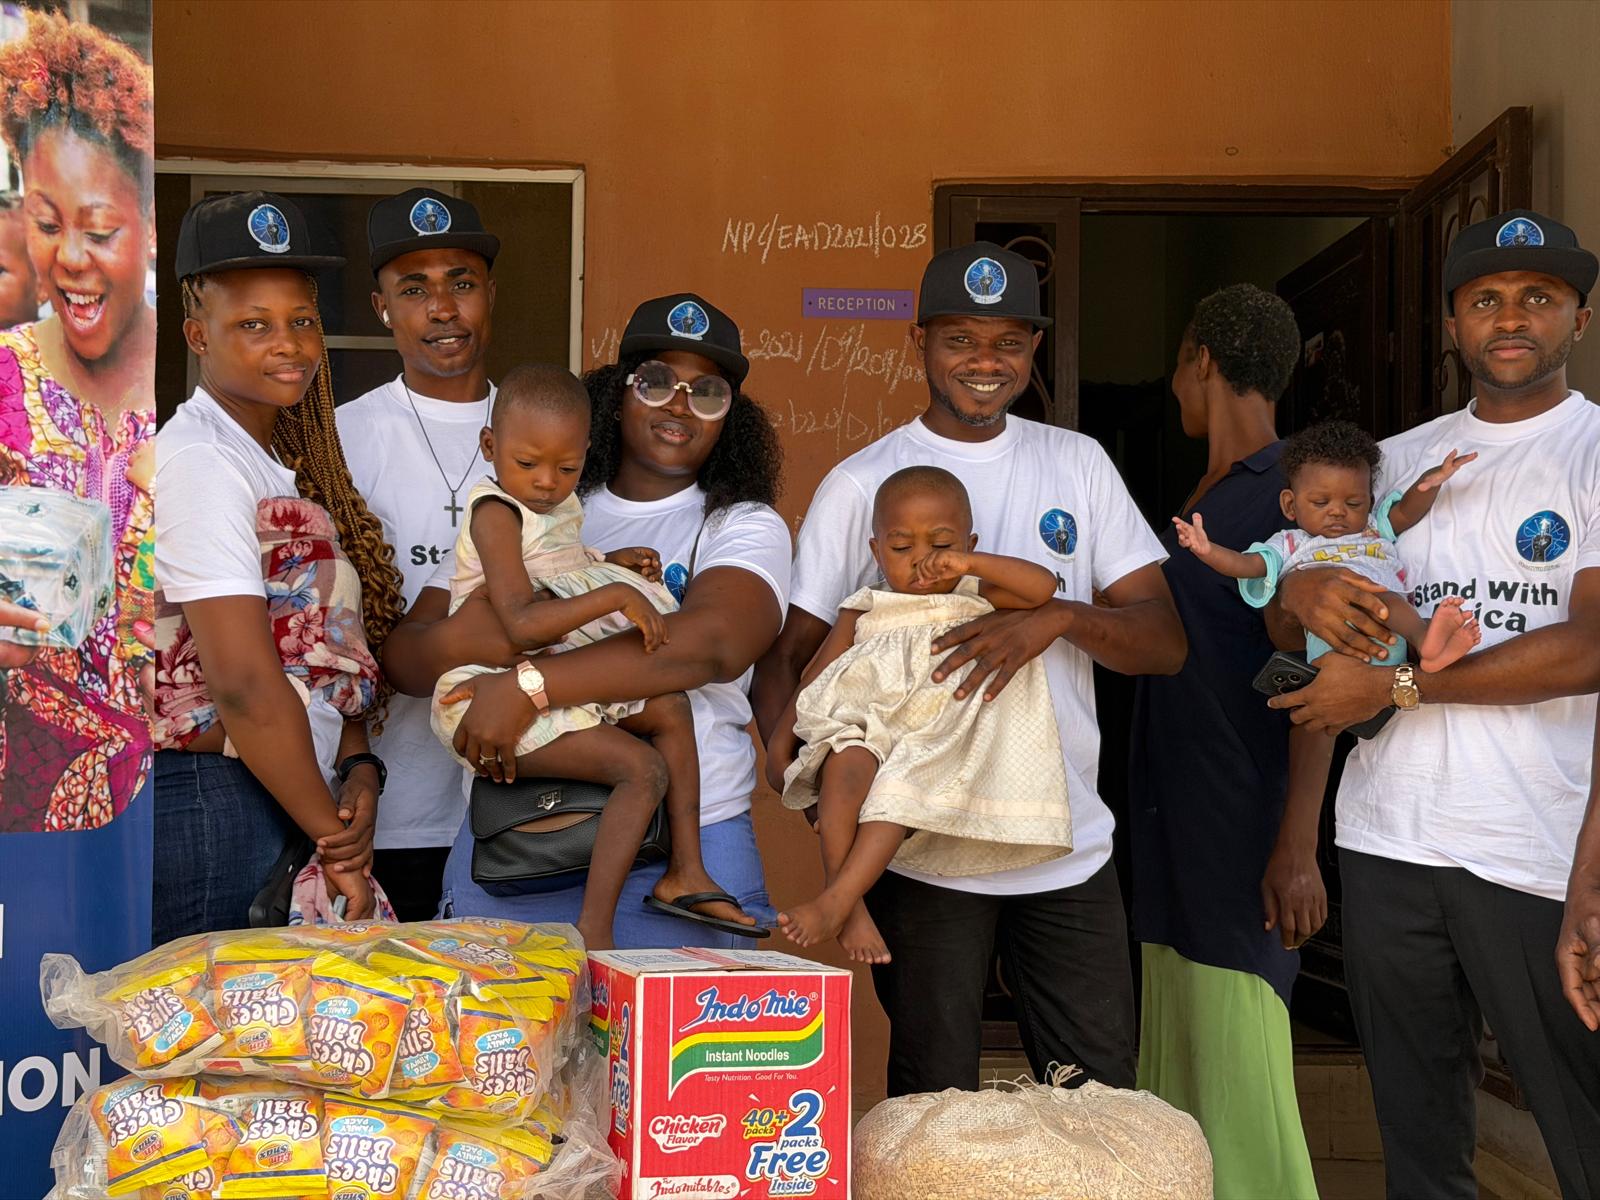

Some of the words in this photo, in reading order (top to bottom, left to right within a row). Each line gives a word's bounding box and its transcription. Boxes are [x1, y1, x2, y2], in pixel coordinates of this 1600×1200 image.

[817, 297, 896, 312] RECEPTION
[1414, 577, 1476, 607] Stand
[1488, 580, 1558, 606] With
[221, 981, 283, 1008] Balls
[133, 993, 186, 1041] Balls
[167, 1024, 187, 1045] PACK
[309, 1015, 366, 1050] Balls
[486, 1037, 516, 1050] FAMILY
[705, 1050, 743, 1063] Instant
[745, 1048, 790, 1062] Noodles
[0, 1047, 101, 1117] ON
[704, 1074, 720, 1084] Tasty
[755, 1073, 772, 1082] Good
[773, 1073, 784, 1081] For
[784, 1089, 822, 1137] 2
[651, 1116, 722, 1135] Chicken
[744, 1126, 775, 1136] packs
[458, 1145, 483, 1155] PACK
[666, 1134, 700, 1145] Flavor
[780, 1136, 820, 1150] packs
[326, 1135, 394, 1166] Balls
[747, 1143, 827, 1175] Free
[438, 1157, 505, 1198] Balls
[650, 1177, 732, 1198] Indomitables
[769, 1177, 814, 1192] Inside
